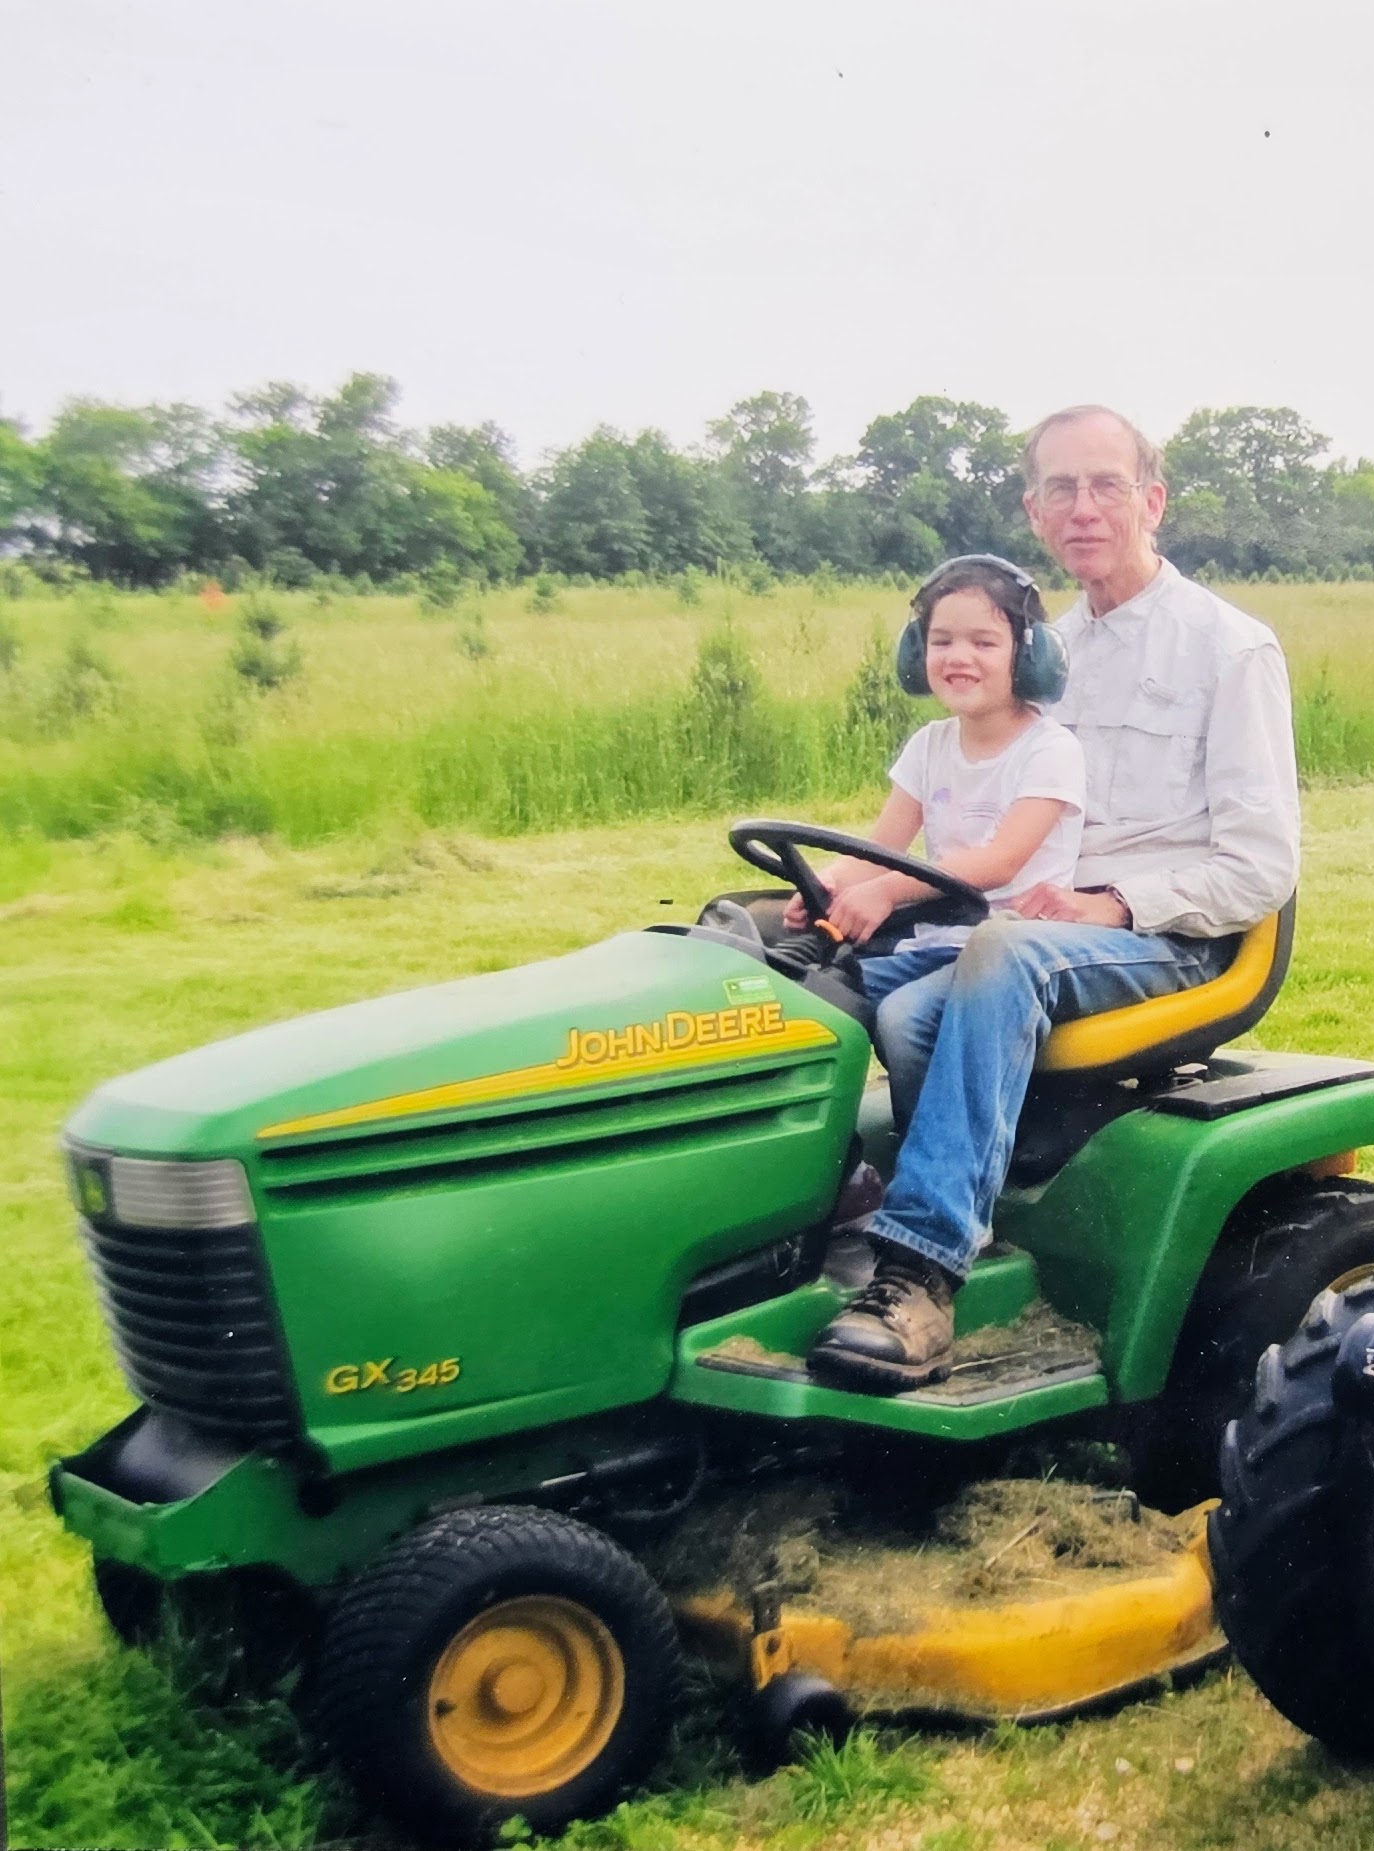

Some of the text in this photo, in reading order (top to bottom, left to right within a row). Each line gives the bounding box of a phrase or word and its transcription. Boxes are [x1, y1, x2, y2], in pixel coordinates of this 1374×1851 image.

[556, 1002, 784, 1068] JOHN DEERE
[324, 1357, 460, 1394] GX 345
